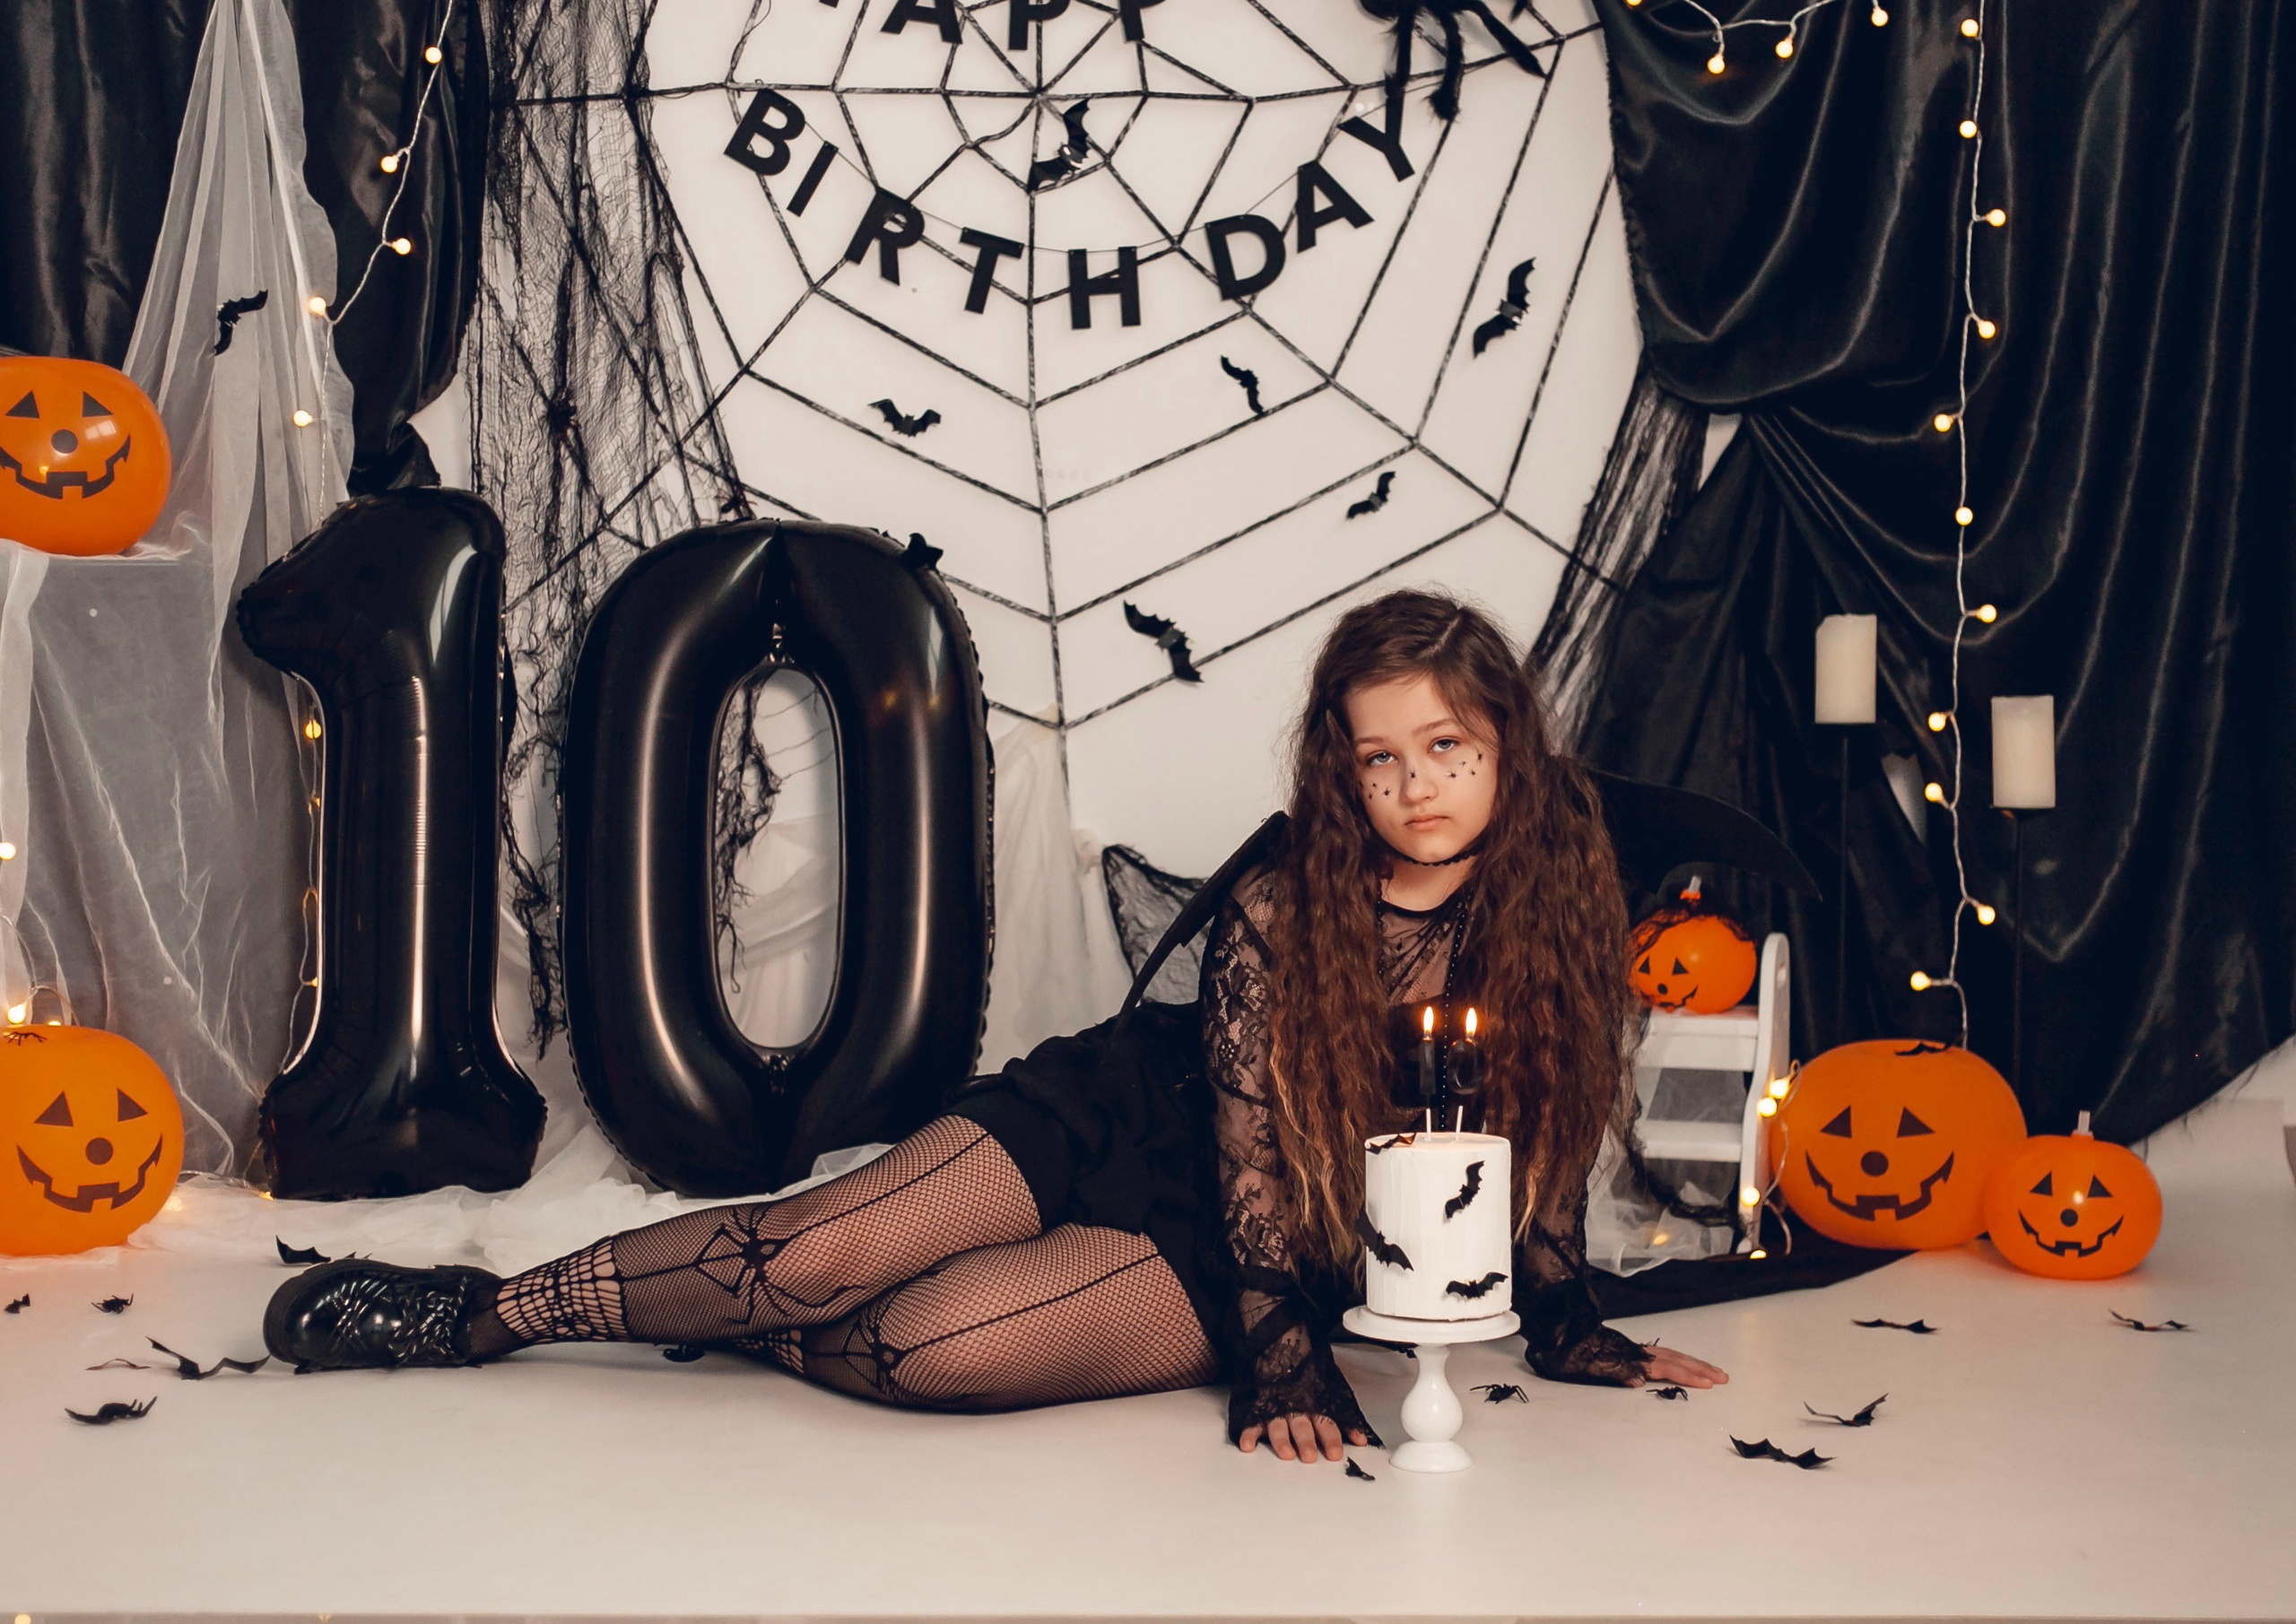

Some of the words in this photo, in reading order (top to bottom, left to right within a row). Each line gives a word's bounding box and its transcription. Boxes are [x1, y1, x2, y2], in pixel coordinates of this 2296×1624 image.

[819, 0, 1165, 50] AP
[724, 75, 1415, 330] BIRTHDAY
[237, 486, 995, 1199] 10
